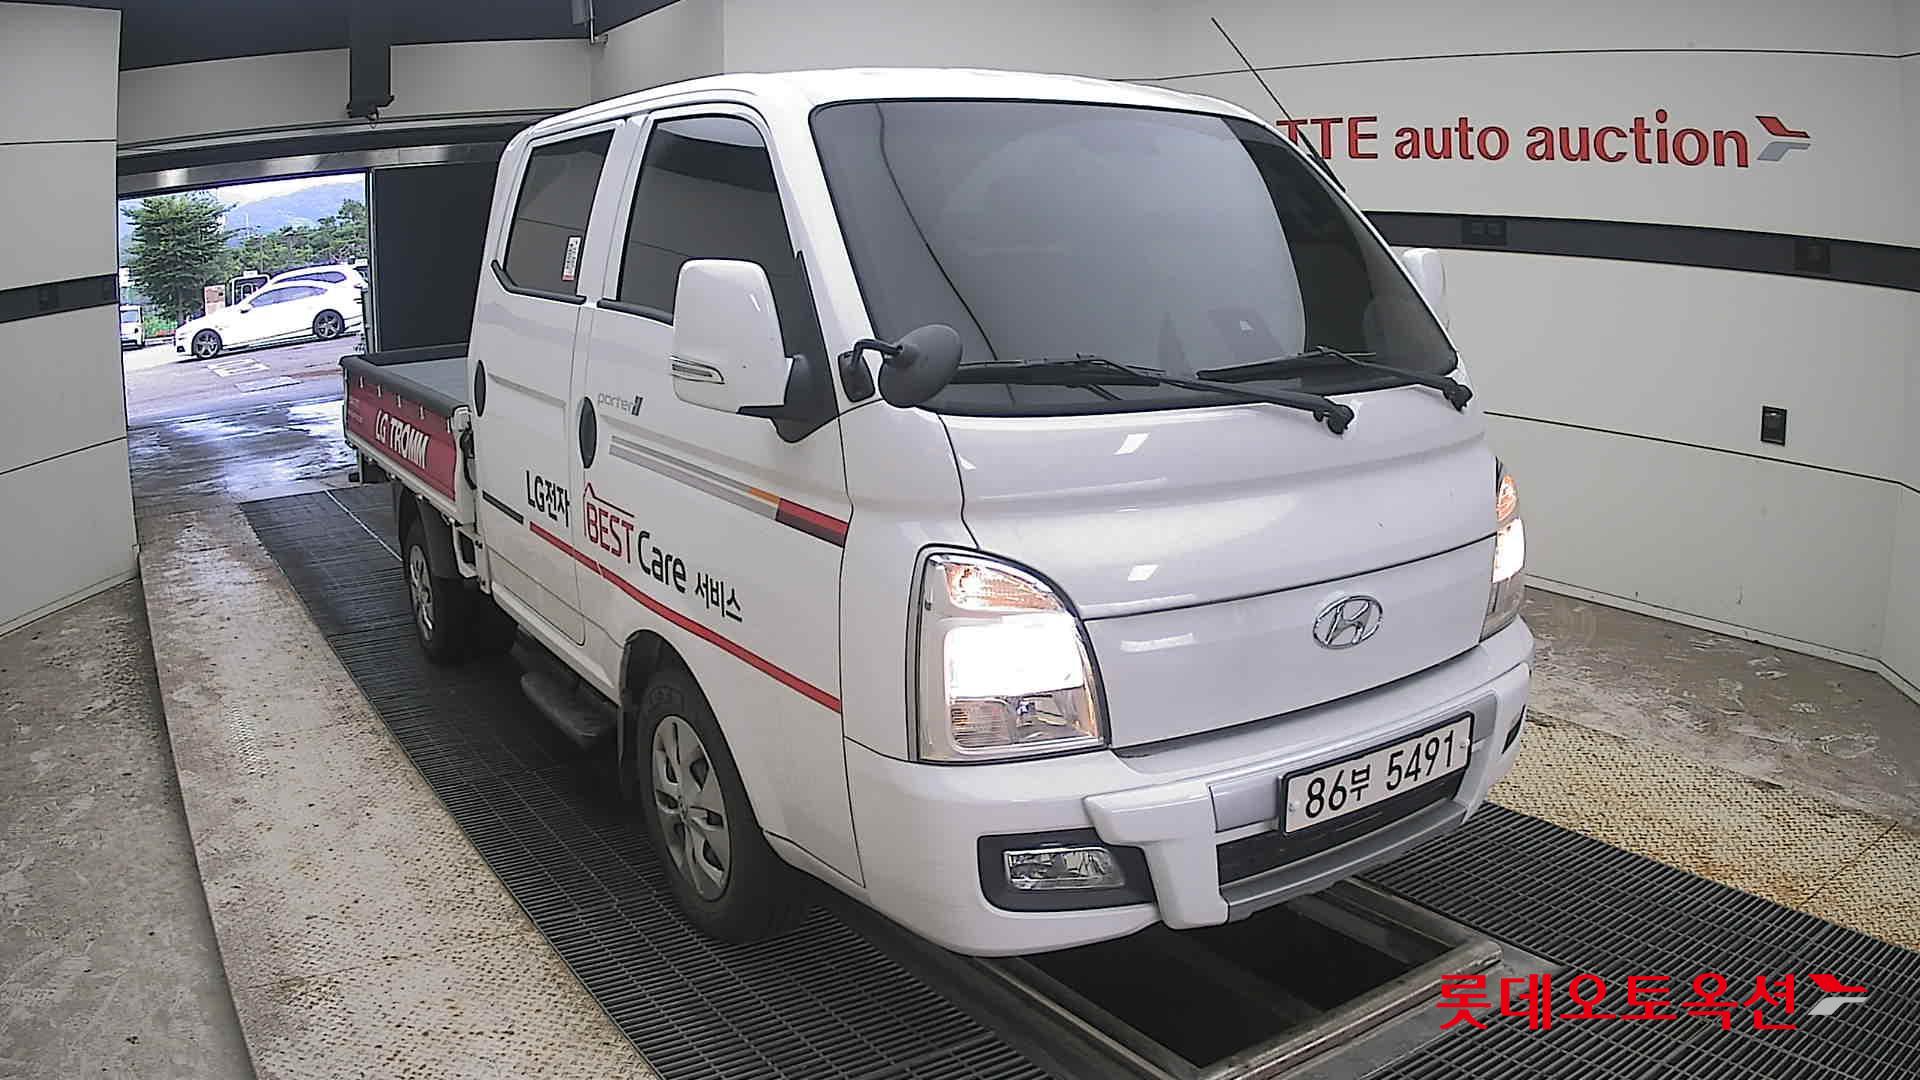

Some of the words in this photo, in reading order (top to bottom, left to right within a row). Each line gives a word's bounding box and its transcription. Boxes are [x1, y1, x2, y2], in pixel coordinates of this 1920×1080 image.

[1394, 116, 1510, 161] auto
[1525, 109, 1750, 168] auction
[376, 409, 390, 444] LG
[390, 417, 430, 470] TROMM
[526, 470, 570, 528] LG전자
[586, 502, 634, 564] BEST
[638, 530, 687, 594] Care
[694, 572, 743, 623] 서비스
[1305, 763, 1371, 819] 86부
[1385, 729, 1454, 791] 5491
